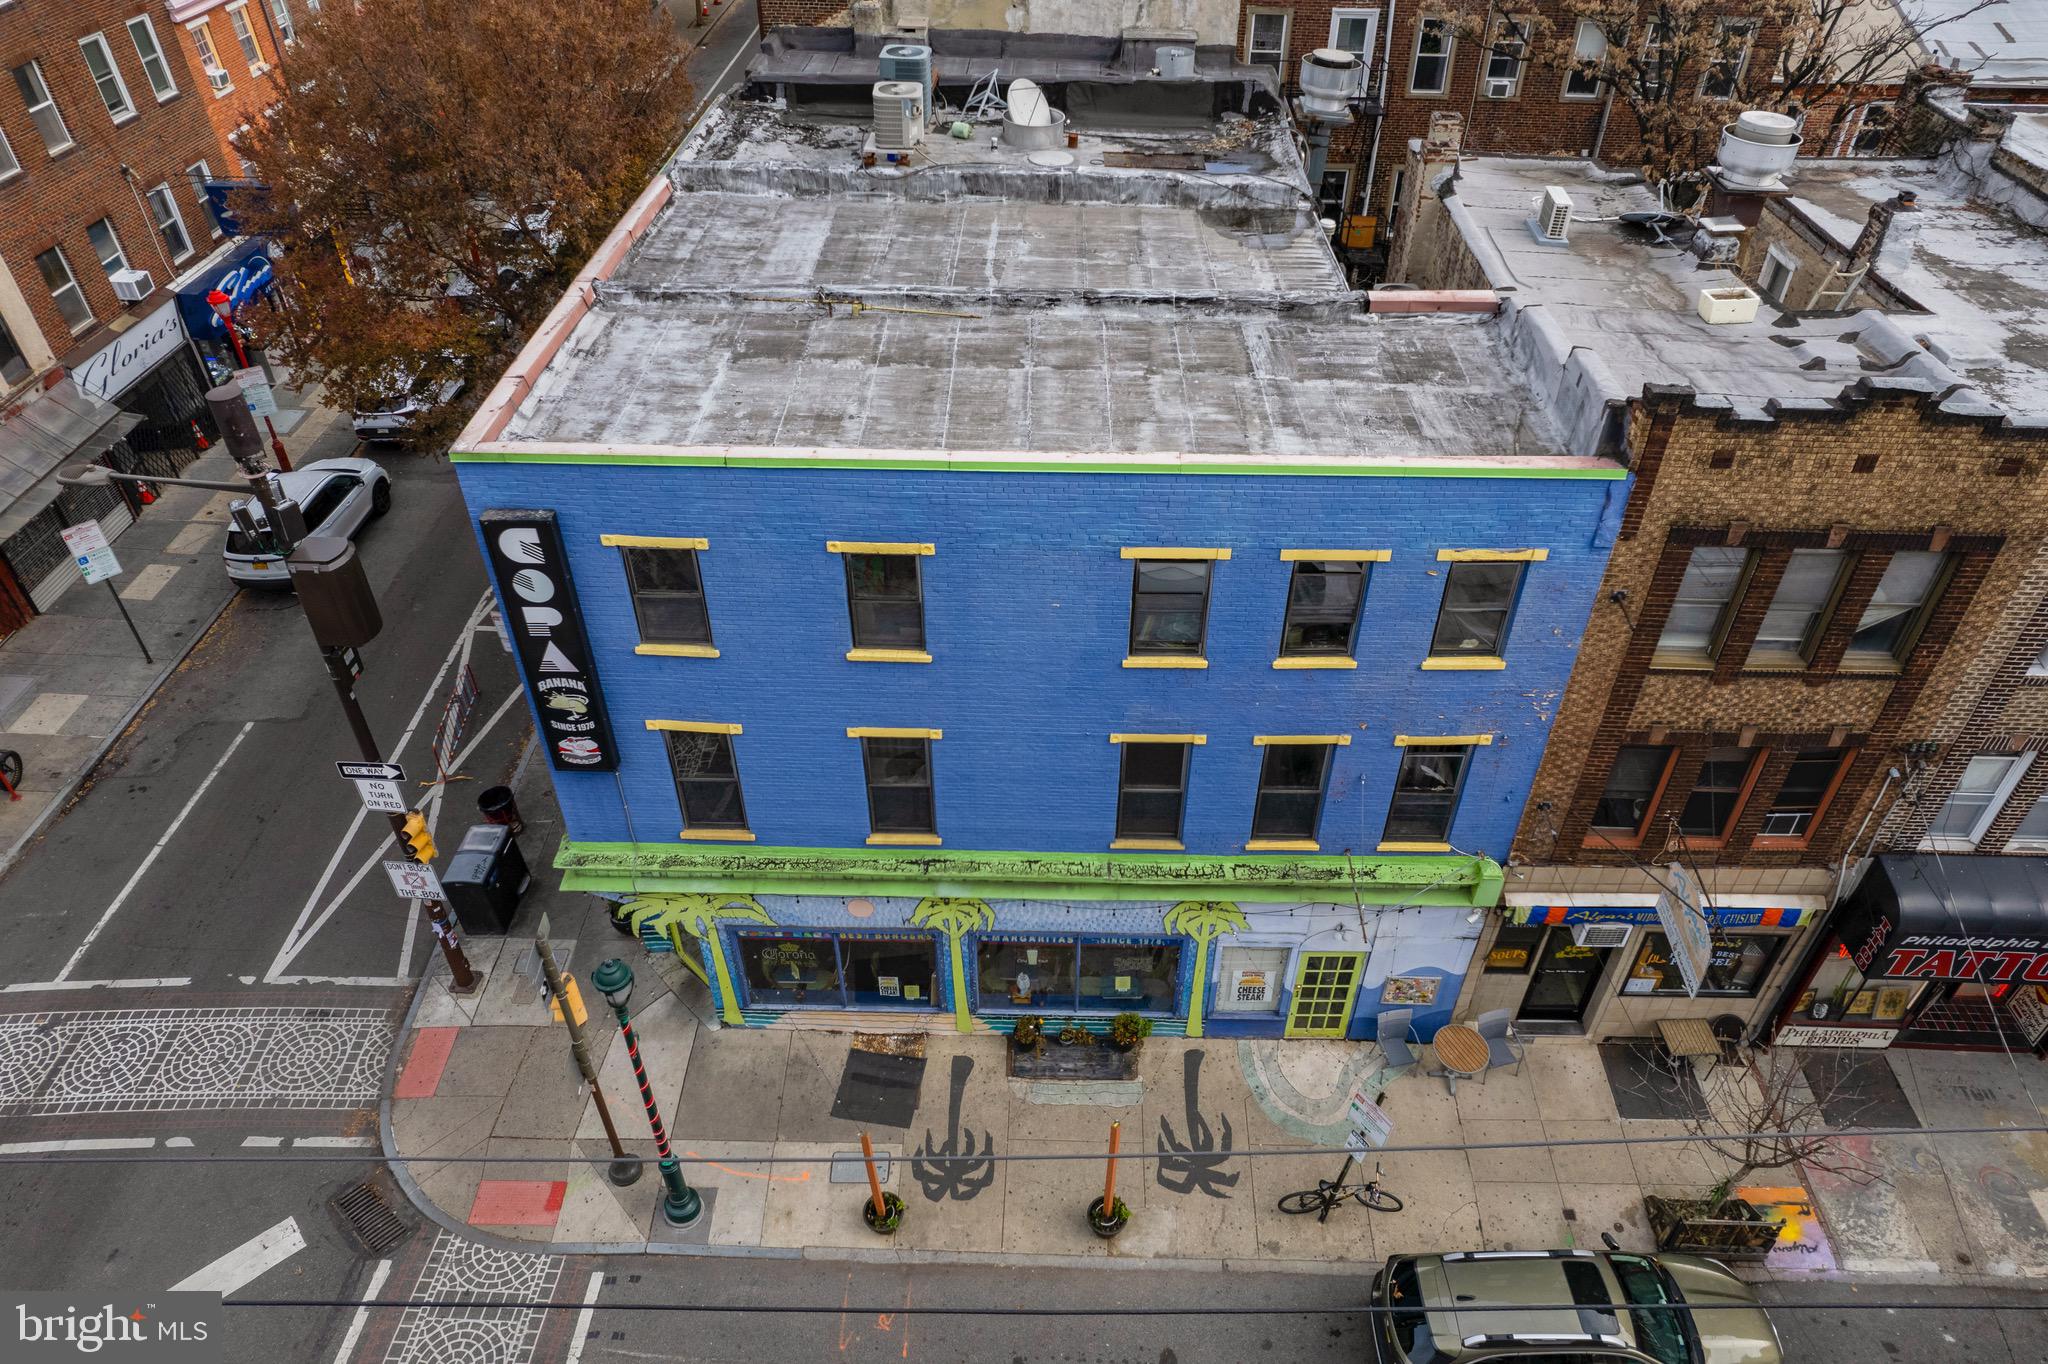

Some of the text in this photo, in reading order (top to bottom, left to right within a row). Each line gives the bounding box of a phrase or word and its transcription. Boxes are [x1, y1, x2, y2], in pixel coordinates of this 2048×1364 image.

[82, 318, 177, 397] Gloria's
[498, 527, 580, 673] COPA
[537, 677, 588, 693] BANANA
[550, 720, 577, 731] SINCE
[369, 782, 385, 790] NO
[368, 791, 394, 800] TURN
[367, 799, 402, 809] ON RED
[408, 864, 432, 873] BLOCK
[400, 889, 442, 899] THE BOX
[1636, 912, 1662, 922] MIDD
[1723, 913, 1762, 924] CUISINE
[992, 935, 1074, 944] MARGARITAS
[1900, 935, 2041, 950] Philadelphia
[1490, 948, 1528, 960] SOUPS
[1715, 950, 1740, 959] BEST
[1237, 986, 1266, 994] CHEESE
[1783, 1027, 1892, 1045] PHILADELPHIA
